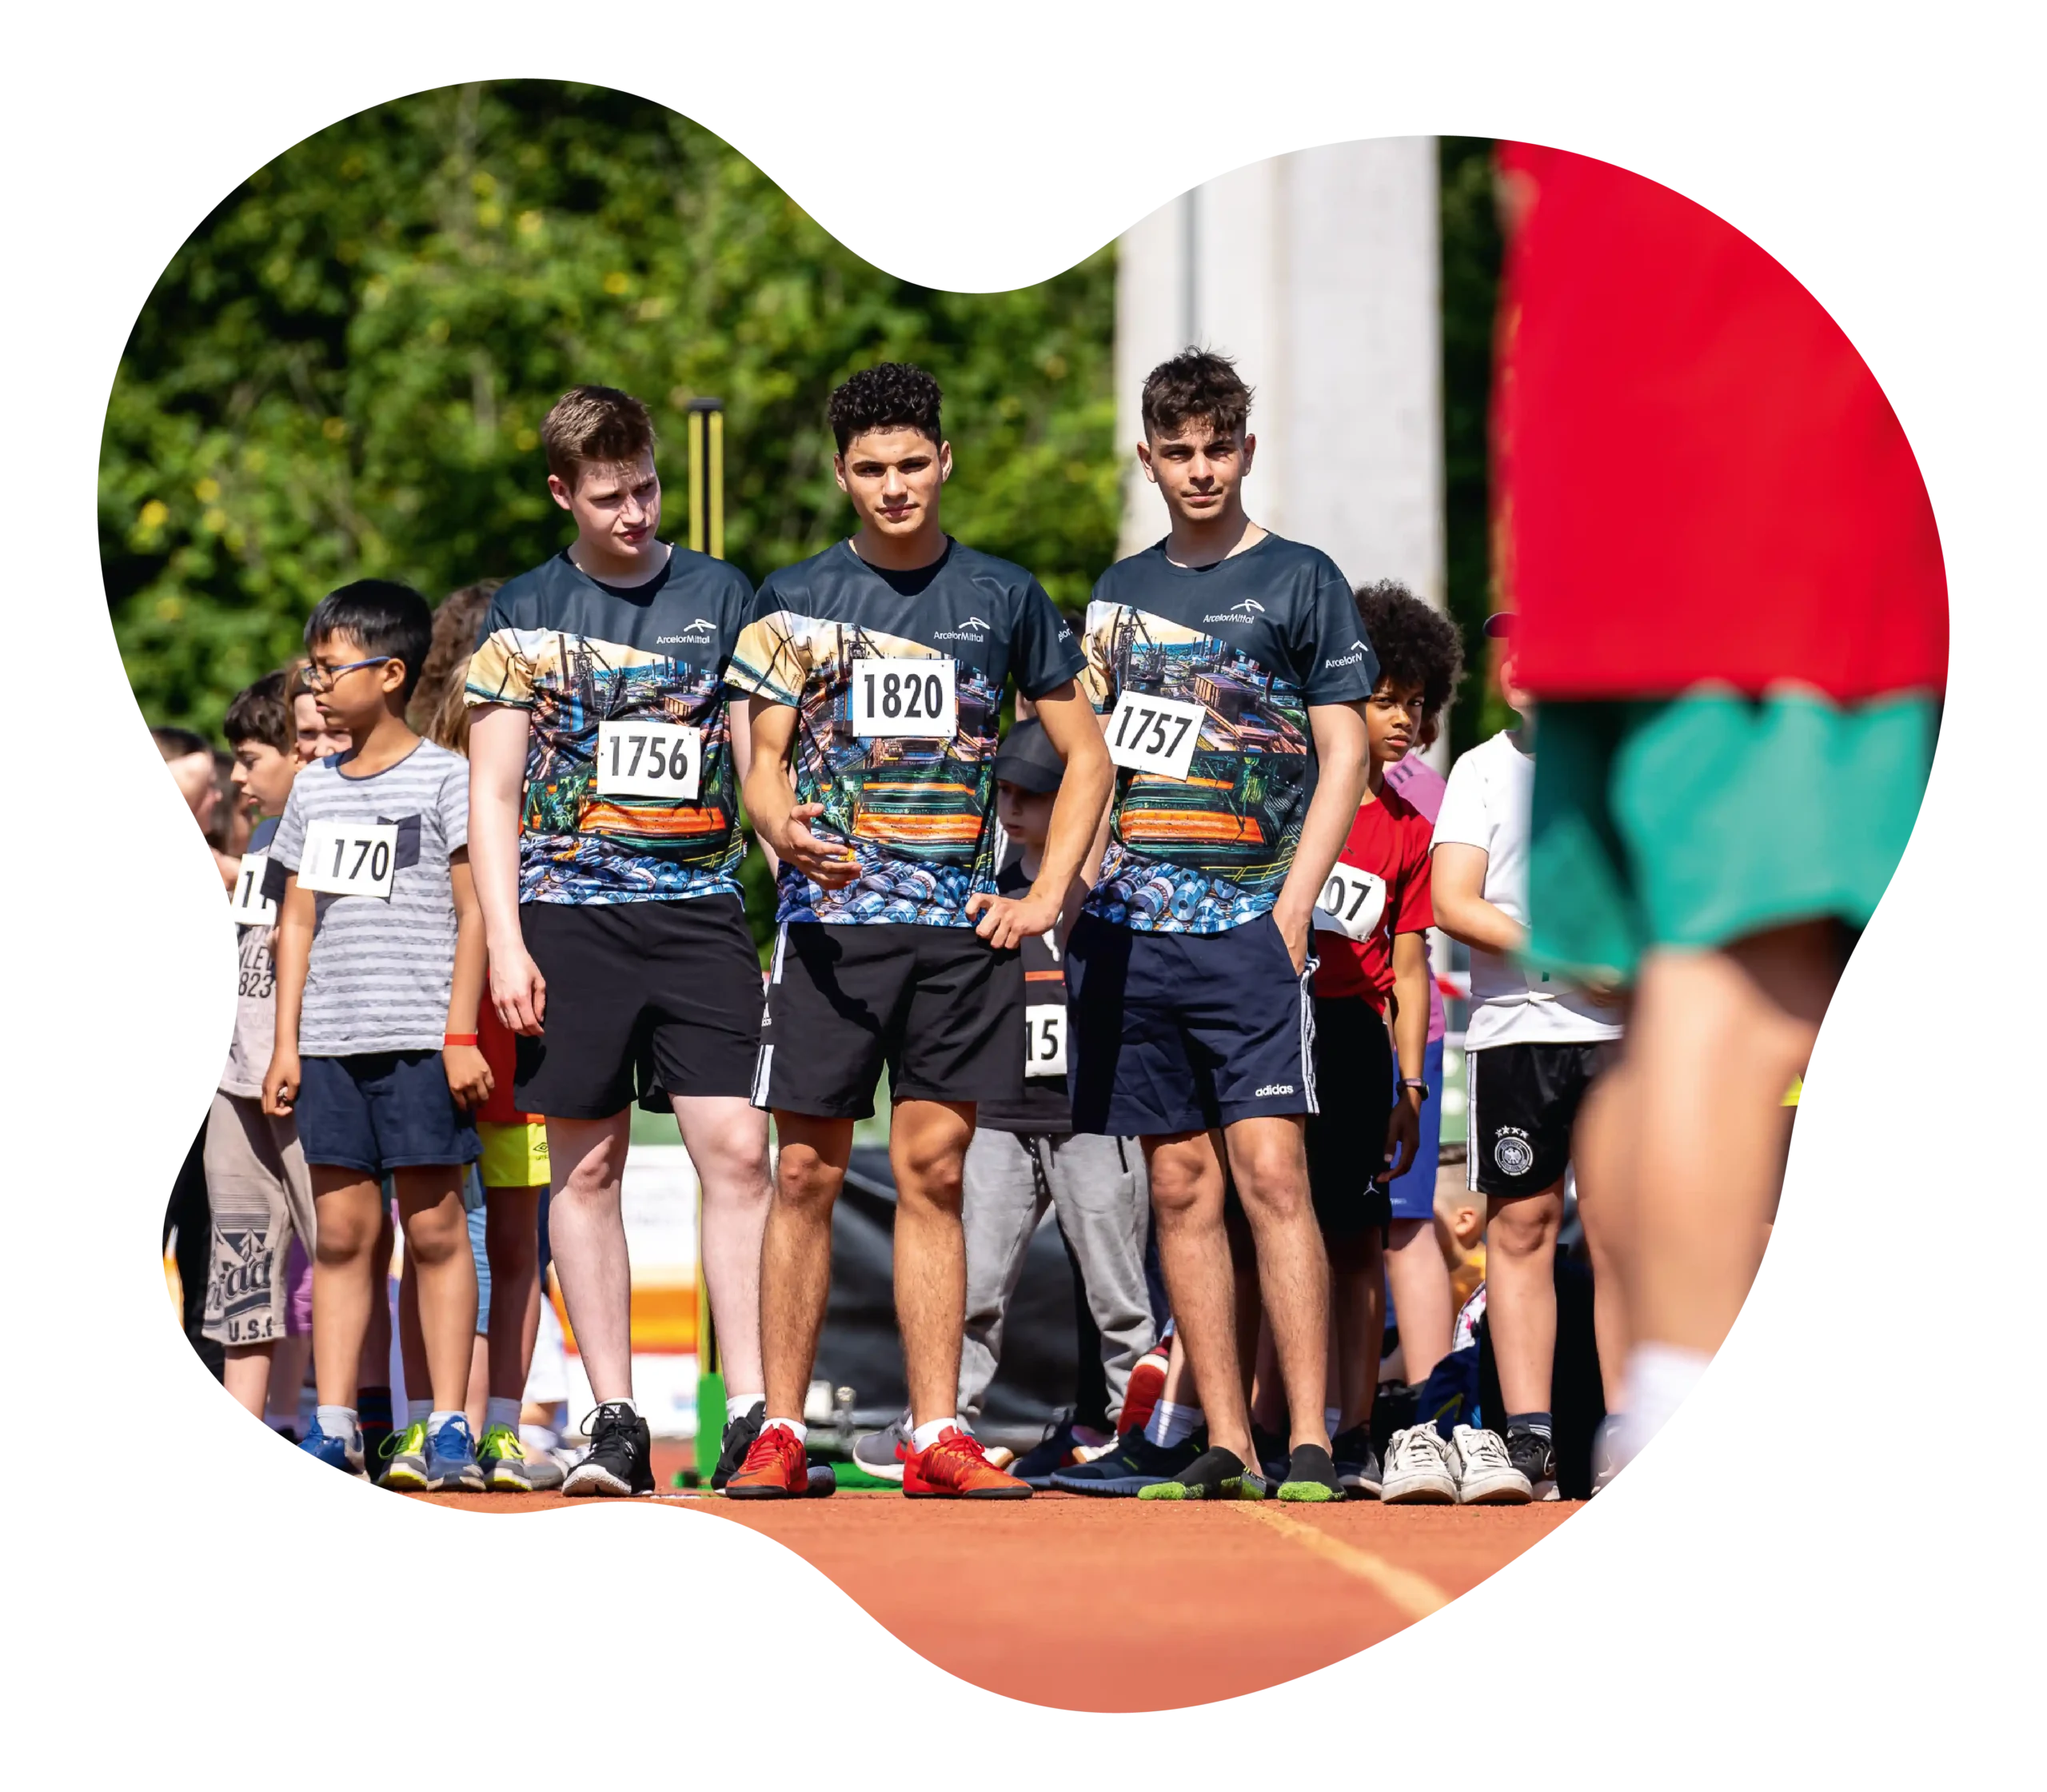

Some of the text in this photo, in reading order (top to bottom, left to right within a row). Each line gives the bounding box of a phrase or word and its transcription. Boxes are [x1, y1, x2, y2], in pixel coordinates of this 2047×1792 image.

[1203, 613, 1255, 625] ArcelorMittal
[656, 635, 710, 645] ArcelorMittal
[933, 631, 984, 643] ArcelorMittal
[864, 672, 944, 719] 1820
[1115, 705, 1193, 758] 1757
[609, 736, 688, 780] 1756
[1255, 1084, 1294, 1097] adidas
